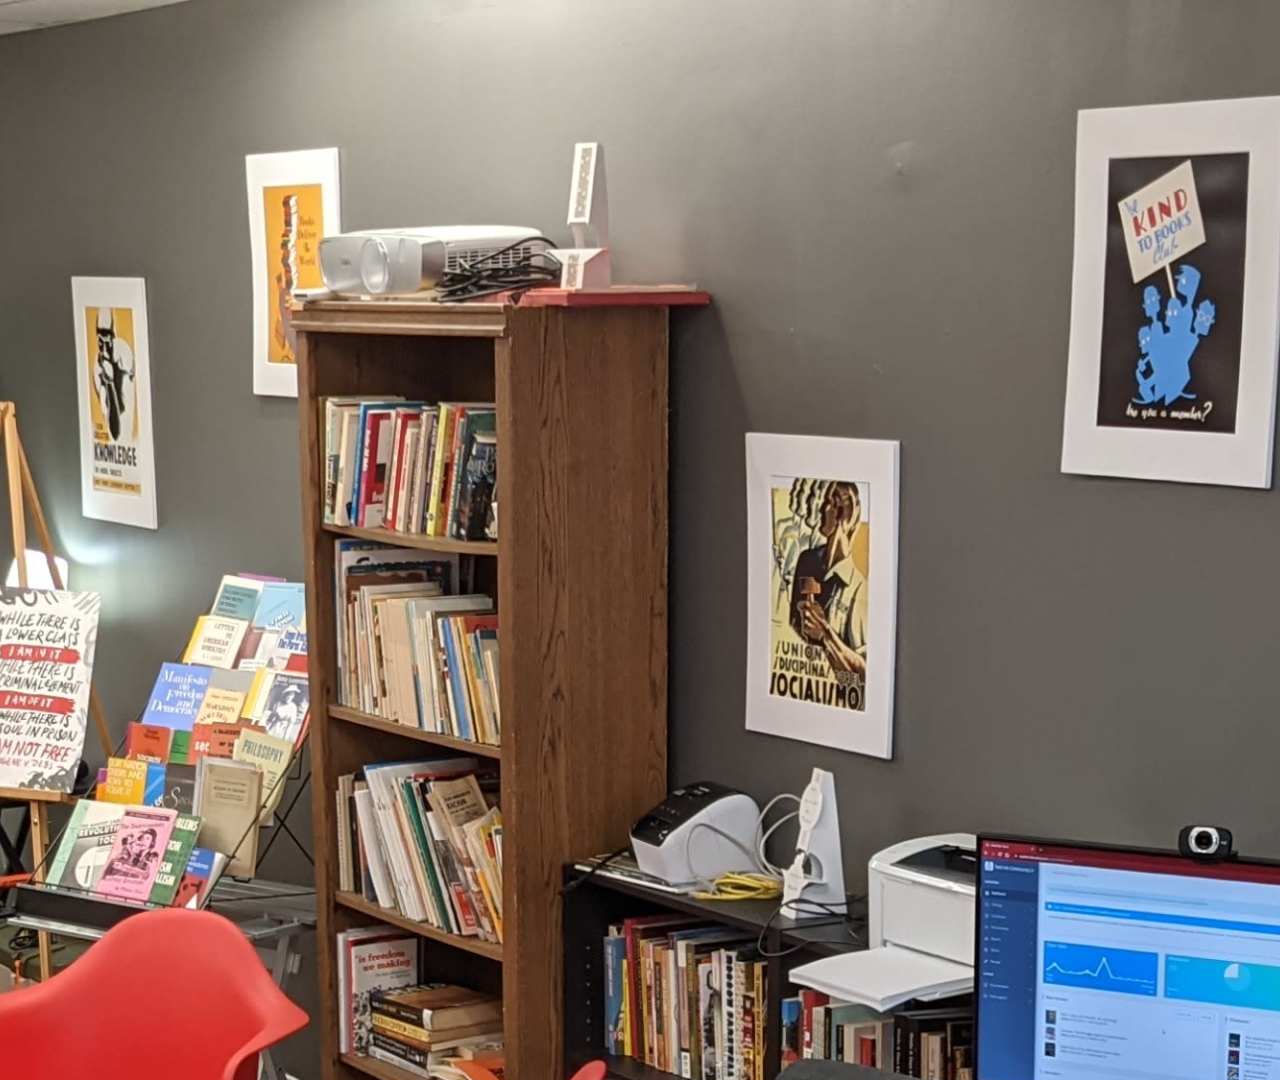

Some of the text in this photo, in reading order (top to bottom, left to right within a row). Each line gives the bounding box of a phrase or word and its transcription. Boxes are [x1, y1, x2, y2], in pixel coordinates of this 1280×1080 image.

[1132, 188, 1188, 237] KIND
[1137, 235, 1153, 253] TO
[94, 442, 137, 467] KNOWLEDGE
[35, 613, 67, 630] THERE
[71, 618, 81, 631] IS
[6, 627, 44, 644] LOWER
[45, 631, 80, 650] CLASS
[17, 647, 33, 657] AM
[49, 650, 62, 660] IT
[26, 663, 60, 680] THERE
[65, 667, 75, 681] IS
[0, 710, 27, 723] WHILE
[26, 712, 57, 726] THERE
[61, 715, 72, 728] IS
[26, 724, 40, 737] IN
[40, 727, 79, 743] PRISON
[15, 738, 42, 757] NOT
[42, 746, 76, 763] FREE
[242, 740, 284, 764] PHILOSOPHY
